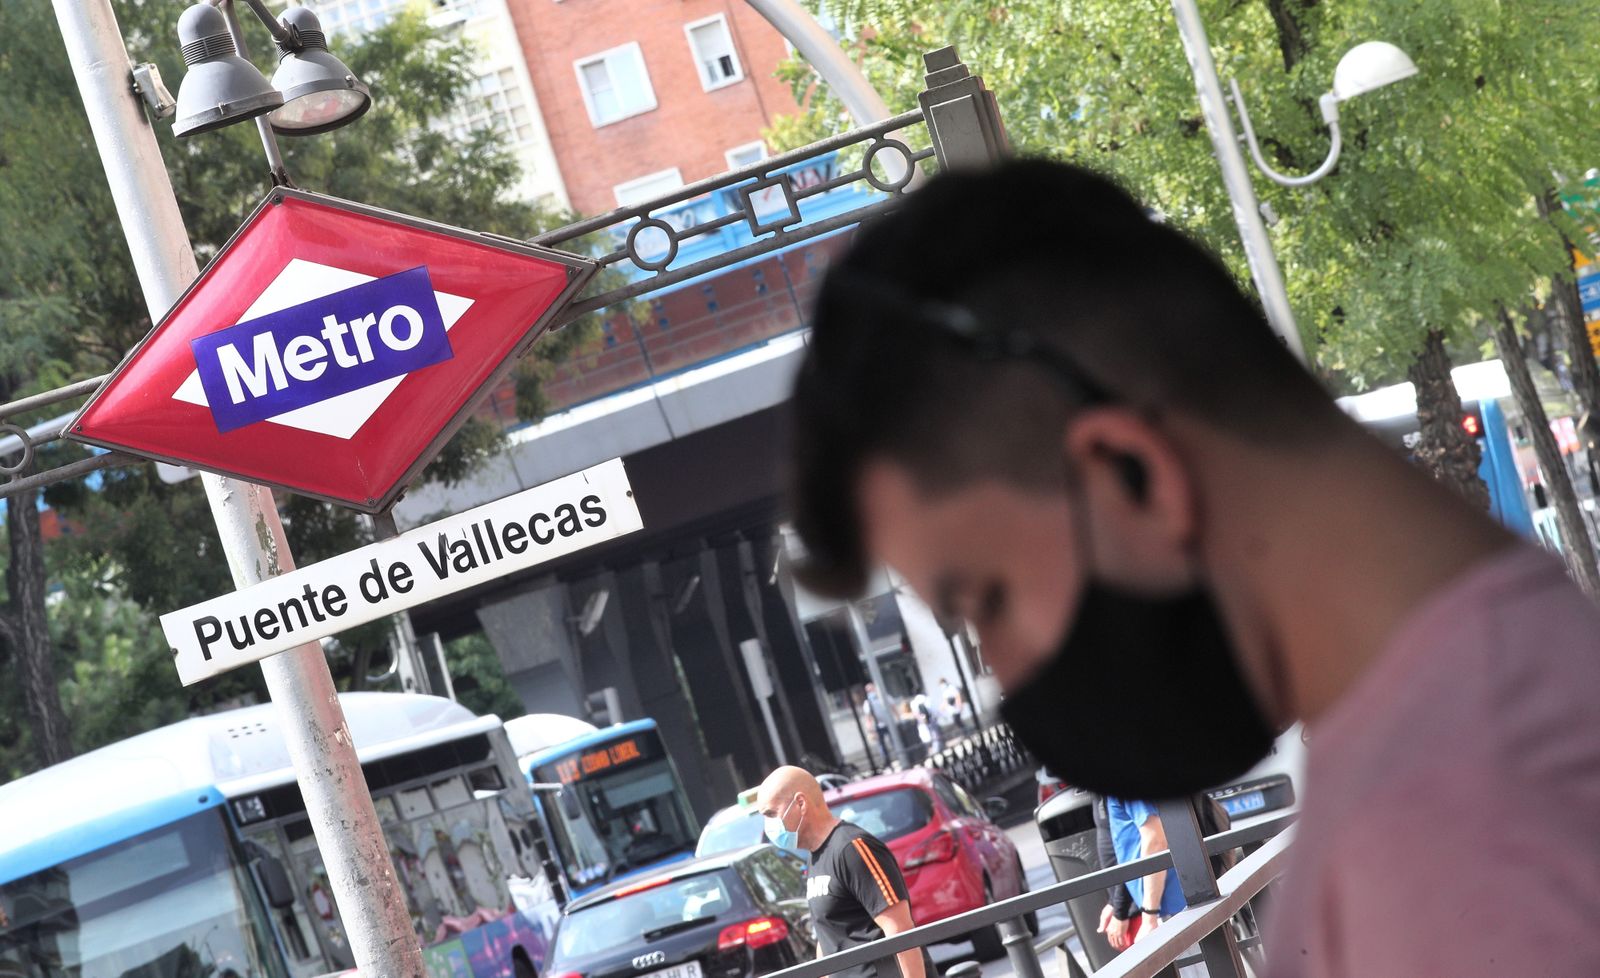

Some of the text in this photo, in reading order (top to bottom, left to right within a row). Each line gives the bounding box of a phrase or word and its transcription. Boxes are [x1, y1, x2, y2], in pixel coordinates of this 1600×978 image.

[217, 305, 424, 405] Metro
[193, 494, 607, 660] Puente de Vallecas
